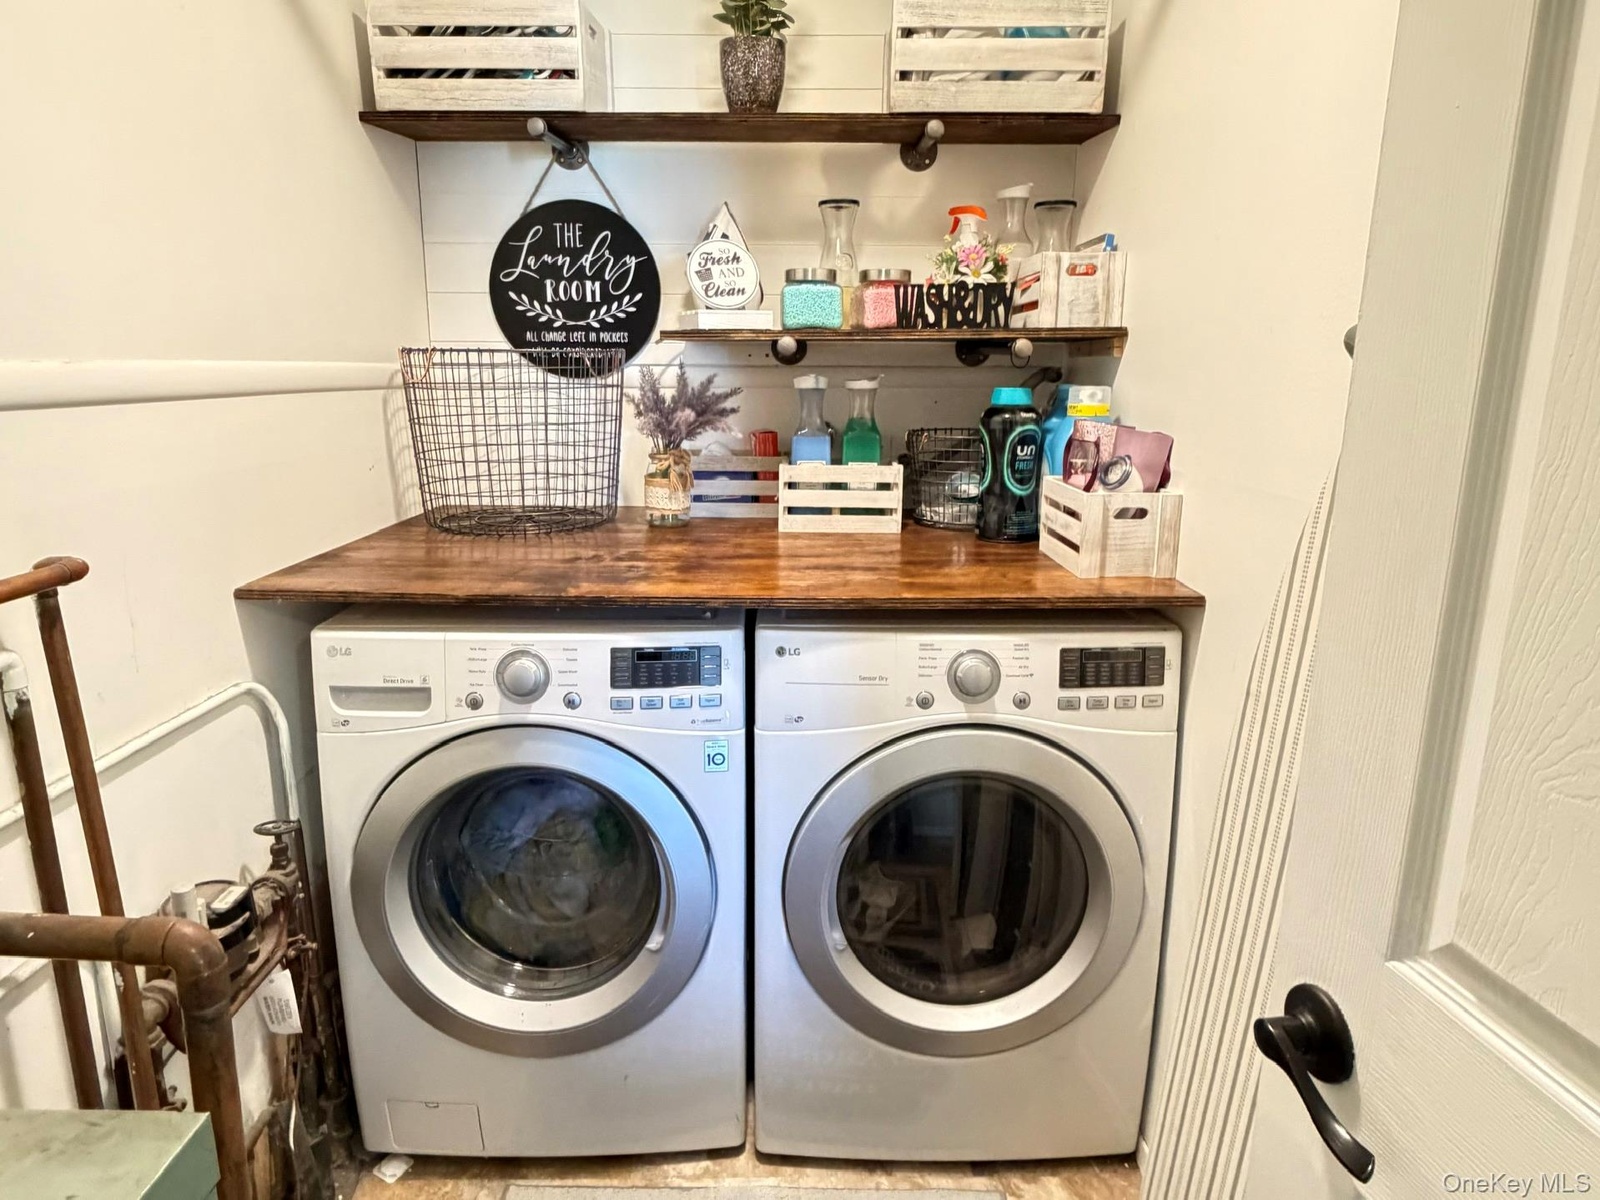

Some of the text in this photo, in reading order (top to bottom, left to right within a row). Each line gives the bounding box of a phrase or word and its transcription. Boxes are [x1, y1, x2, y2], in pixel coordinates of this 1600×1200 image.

[553, 222, 584, 248] THE
[500, 225, 648, 295] Laundry
[698, 252, 742, 269] Fresh
[718, 267, 745, 279] AND
[544, 279, 602, 303] ROOM
[702, 281, 746, 298] Clean
[893, 281, 1017, 329] WASH&DRY
[526, 331, 539, 342] ALL
[339, 647, 352, 657] LG
[788, 648, 801, 657] LG
[878, 675, 889, 683] Dry
[707, 752, 726, 766] 10
